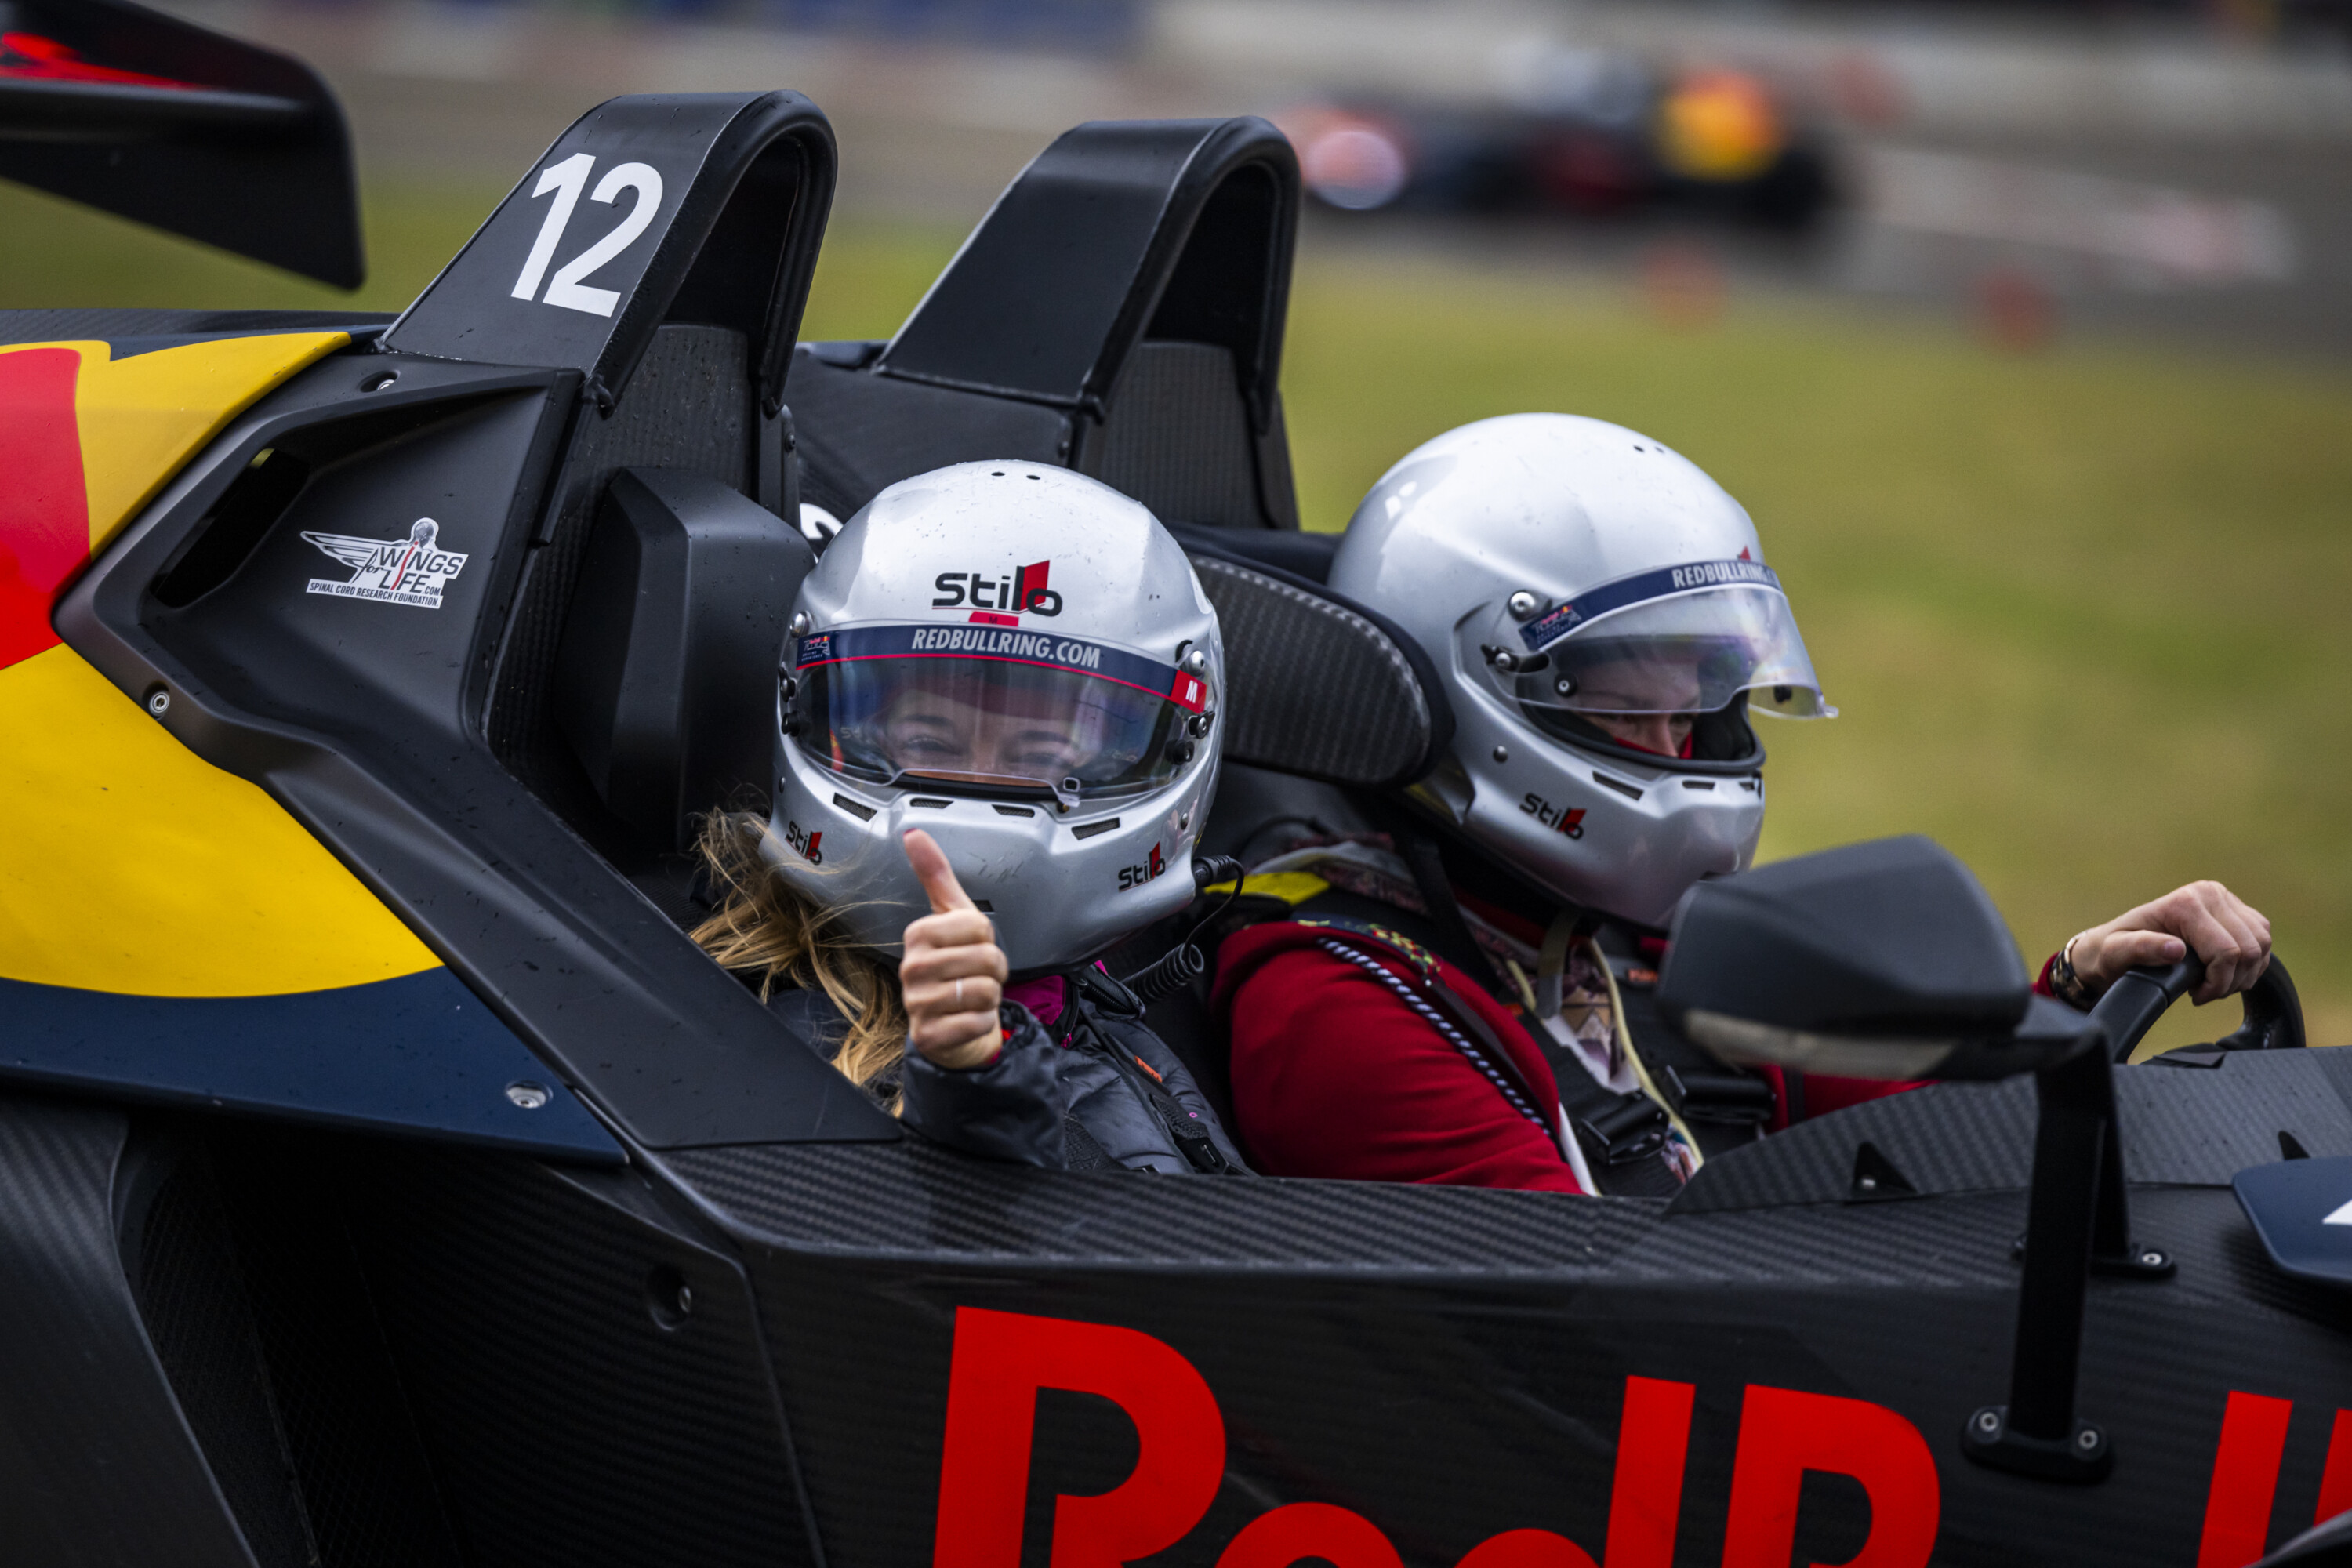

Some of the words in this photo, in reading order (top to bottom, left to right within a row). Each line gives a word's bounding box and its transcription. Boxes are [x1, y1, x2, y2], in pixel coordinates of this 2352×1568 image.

[511, 152, 663, 318] 12
[309, 582, 334, 593] SPINAL
[336, 584, 355, 596] CORD
[356, 587, 392, 601] RESEARCH
[932, 560, 1063, 617] Stilo
[912, 628, 1101, 669] REDBULLRING.COM
[1185, 680, 1198, 703] M
[1519, 791, 1586, 840] Stilo
[785, 820, 822, 866] Stilo
[1118, 842, 1166, 891] Stilo
